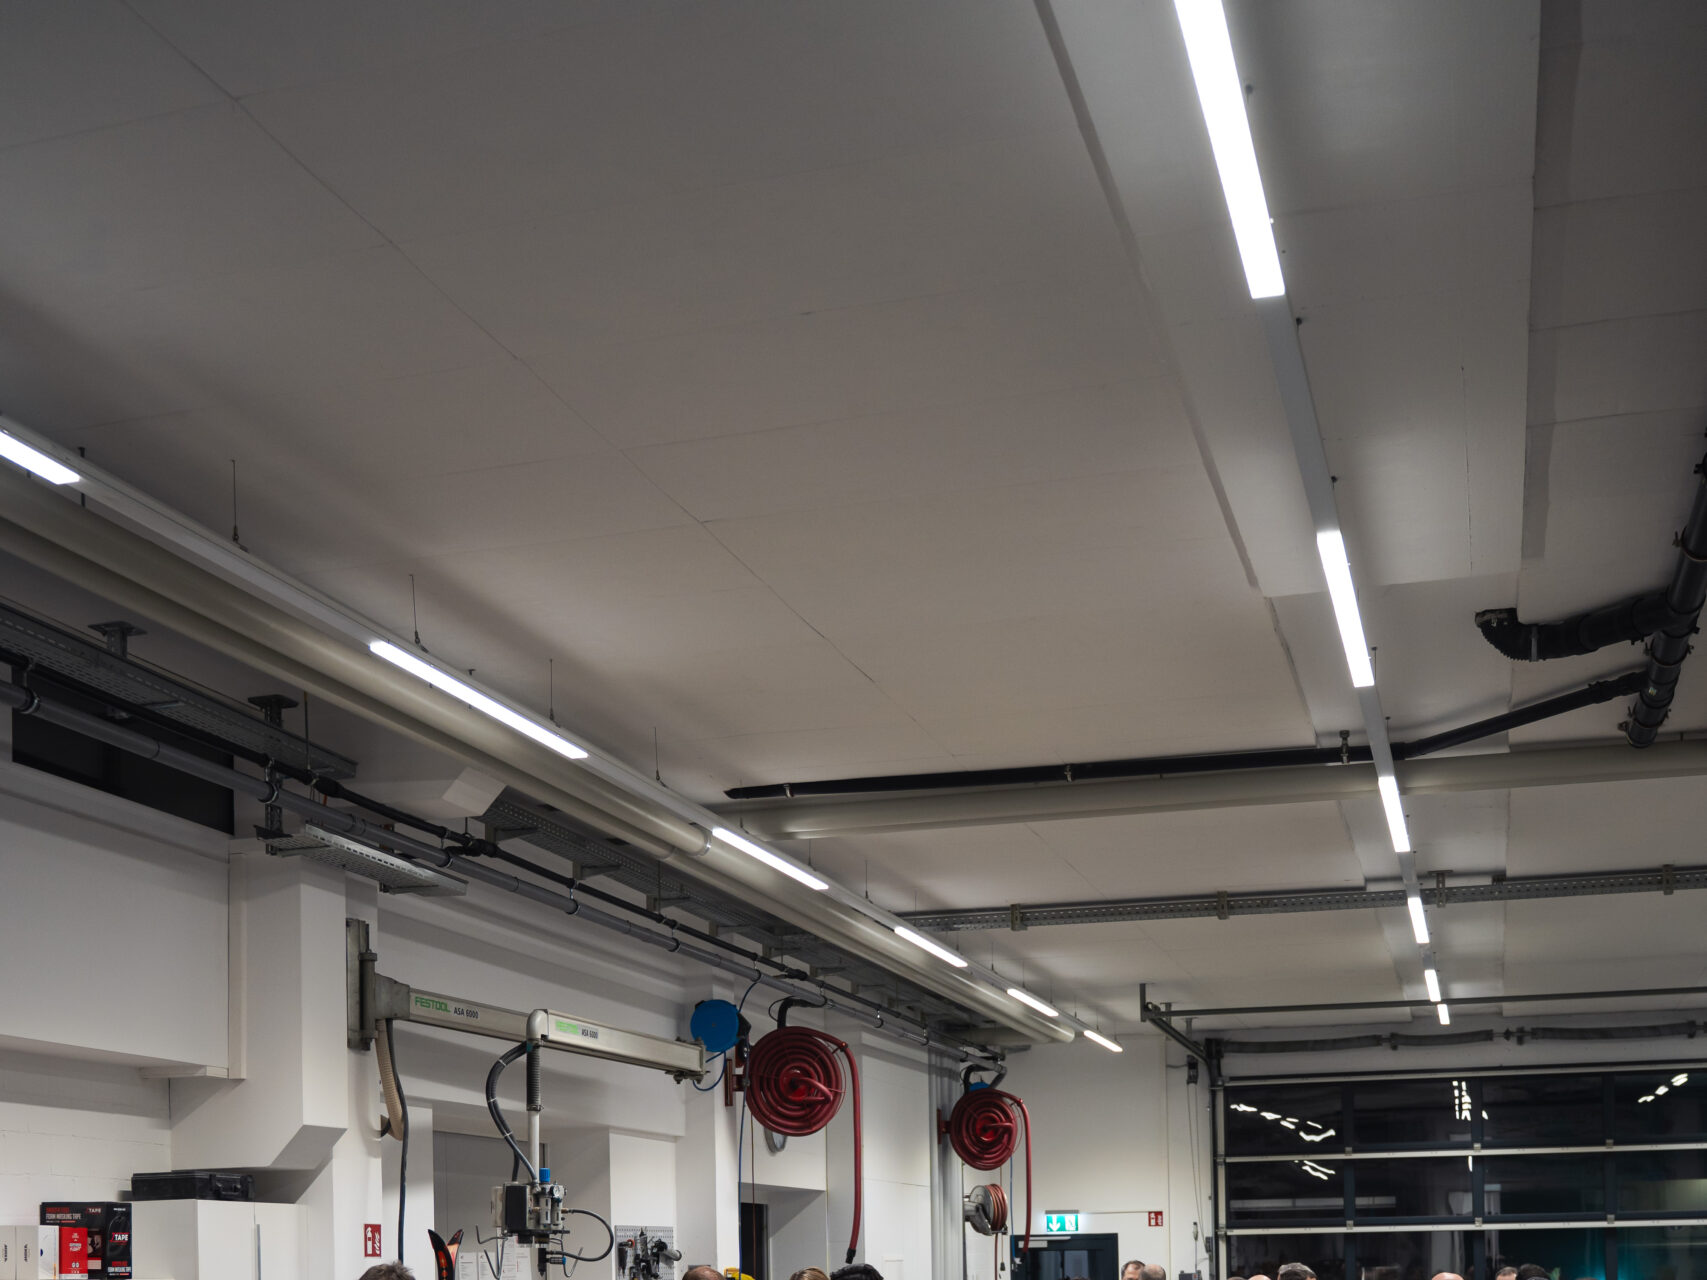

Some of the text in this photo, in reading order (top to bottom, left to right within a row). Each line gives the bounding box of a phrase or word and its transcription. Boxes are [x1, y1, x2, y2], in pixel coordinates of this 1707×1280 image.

[414, 996, 479, 1019] FESTOOL ASA 6000
[581, 1028, 589, 1037] ASA
